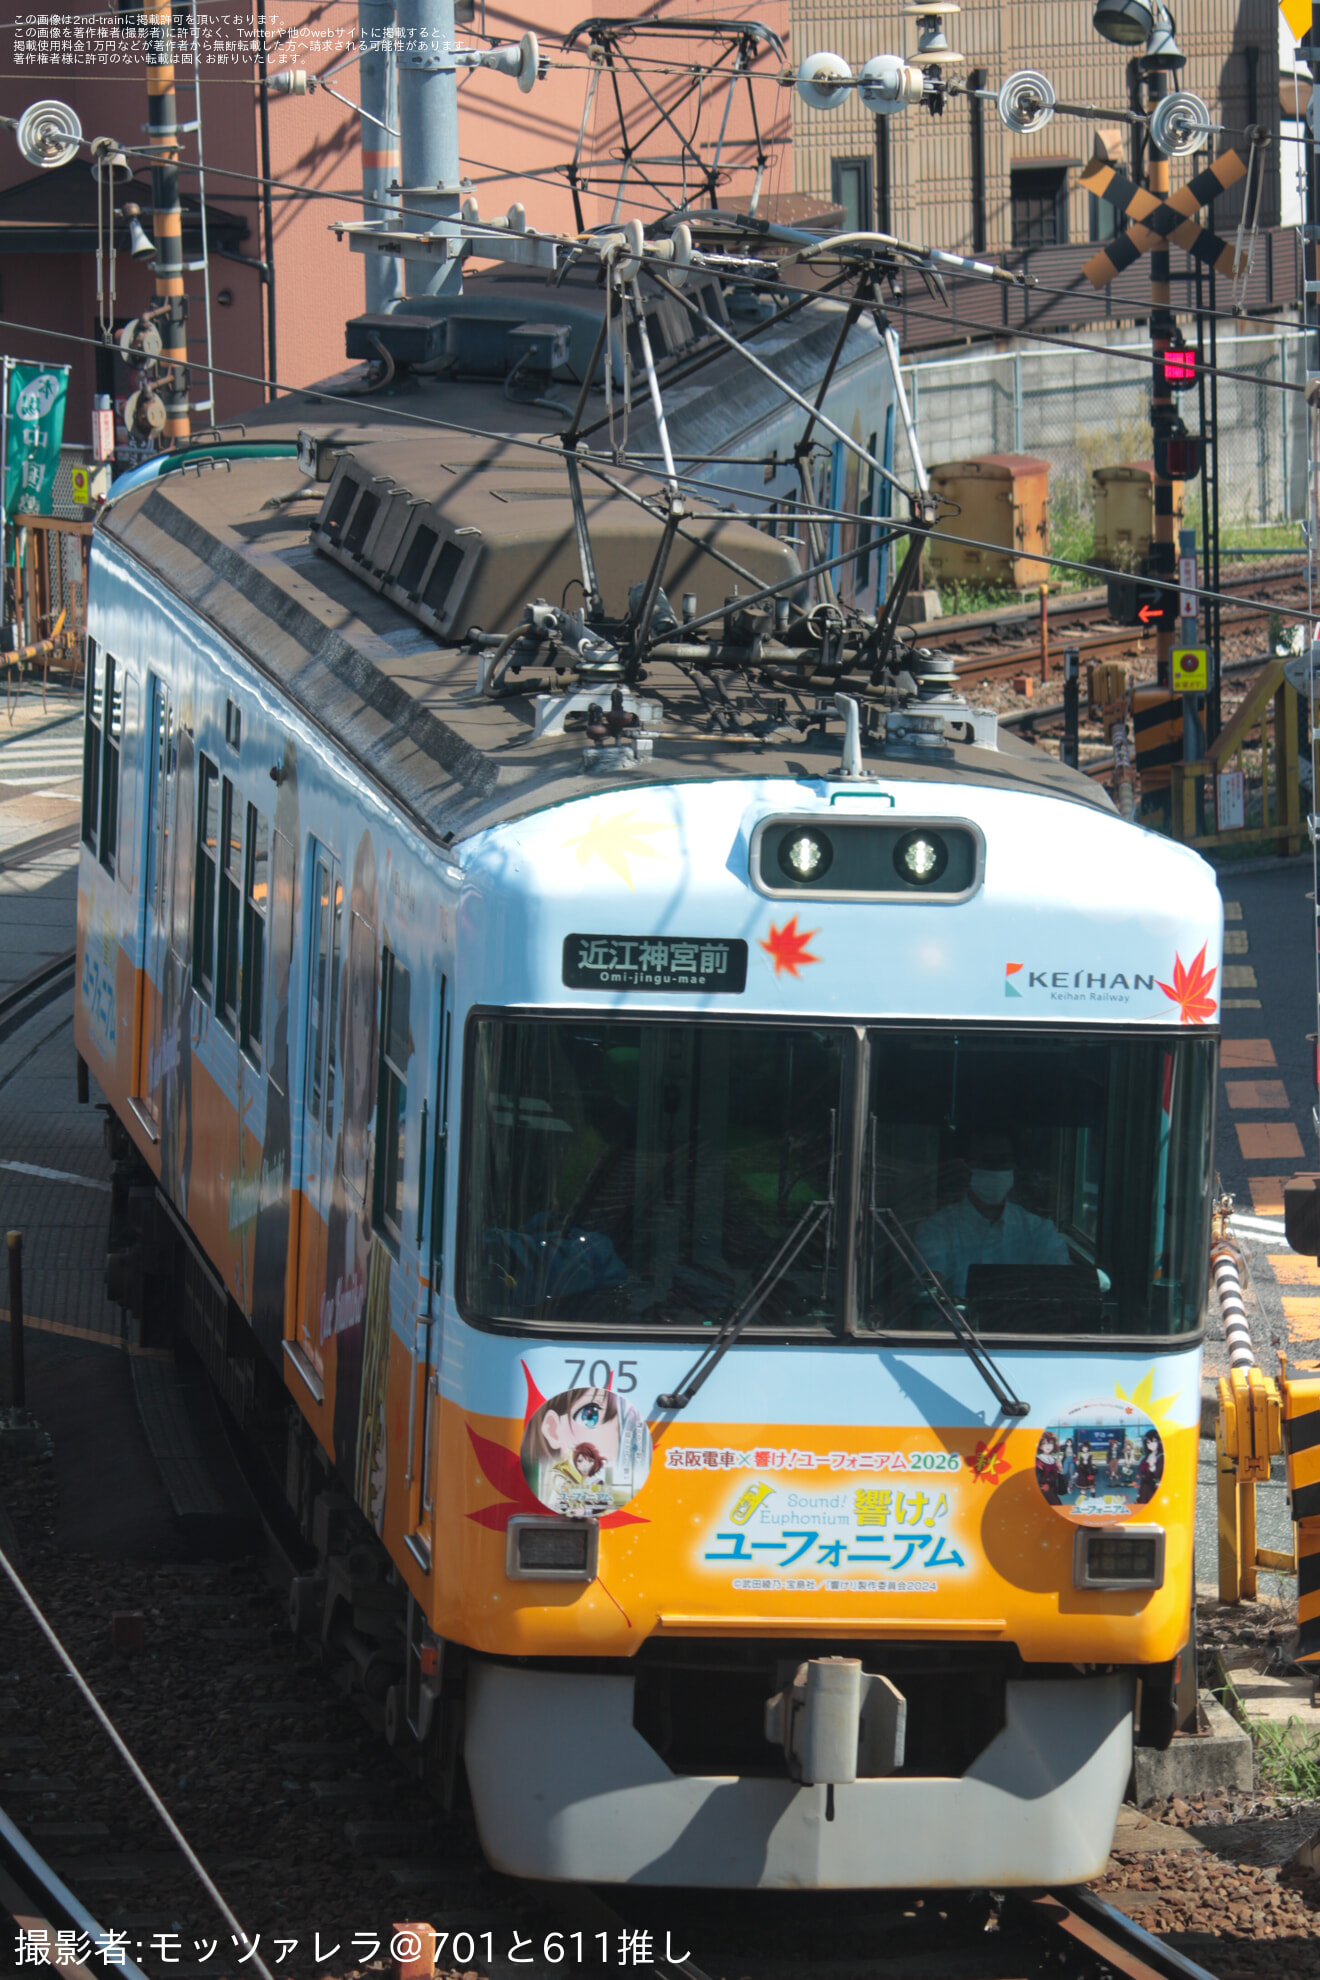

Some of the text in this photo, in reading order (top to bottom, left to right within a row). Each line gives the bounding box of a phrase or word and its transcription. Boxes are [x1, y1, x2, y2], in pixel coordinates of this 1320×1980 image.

[577, 939, 730, 974] 近江神宮前
[599, 971, 707, 986] Omi-jingu-mae
[1051, 991, 1131, 1003] Keihan Railway
[564, 1359, 639, 1394] 705
[974, 1450, 1001, 1476] 秋
[786, 1493, 849, 1510] Sound!
[759, 1510, 851, 1527] Euphonium
[704, 1530, 967, 1571] ユーフォニアム
